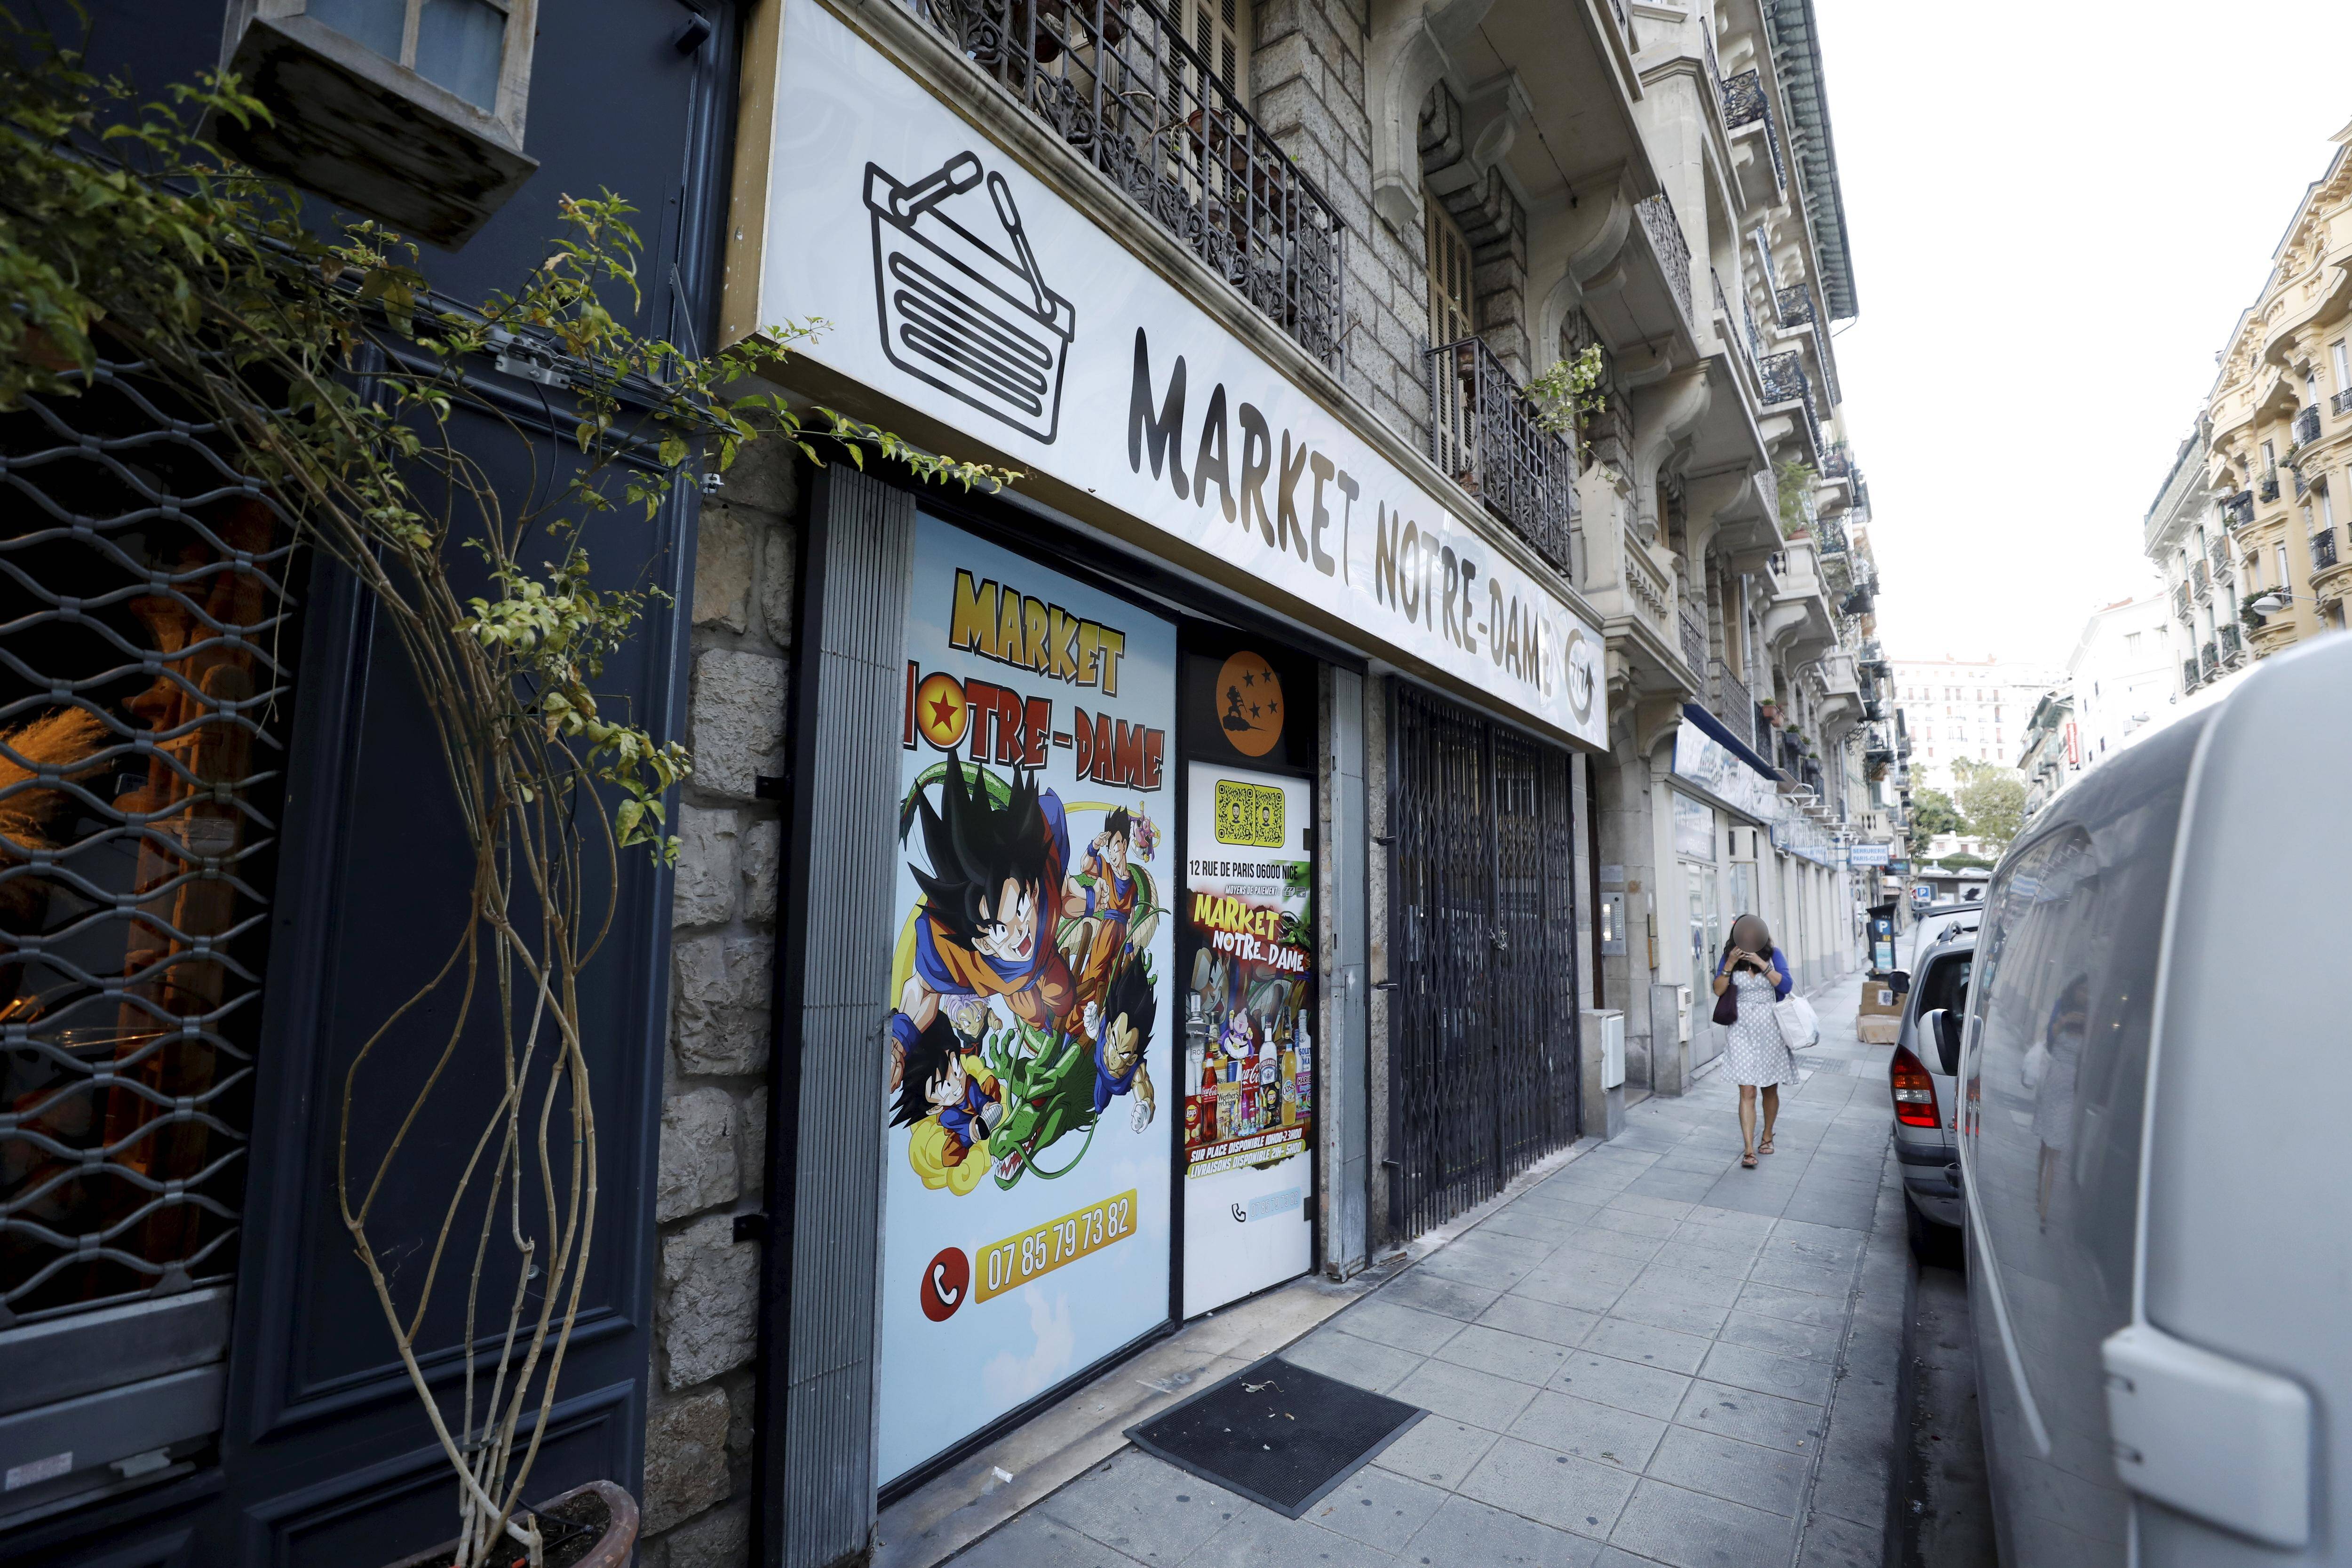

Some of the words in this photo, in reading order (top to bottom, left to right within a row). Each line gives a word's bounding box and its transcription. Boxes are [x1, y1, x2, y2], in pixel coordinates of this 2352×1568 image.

[1128, 326, 1359, 587] MARKET
[948, 567, 1126, 698] MARKET
[904, 659, 1166, 793] OTRE-DAME
[1190, 860, 1200, 876] 12
[1202, 861, 1218, 876] RUE
[1220, 861, 1230, 877] DE
[1232, 862, 1254, 878] PARIS
[1256, 864, 1280, 879] 06000
[1282, 865, 1298, 880] NICE
[1225, 885, 1246, 895] MOYENS
[1247, 886, 1253, 895] DE
[1193, 894, 1279, 941] MARKET
[1879, 920, 1888, 933] P
[1218, 1091, 1239, 1102] Werther's
[1282, 1083, 1295, 1095] Oasis
[1191, 1148, 1204, 1162] SUR
[1206, 1143, 1227, 1159] PLACE
[1228, 1136, 1264, 1154] DISPONIBLE
[1190, 1158, 1232, 1178] LIVRAISONS
[1232, 1149, 1270, 1168] DISPONIBLE
[1251, 1202, 1260, 1217] 07
[1261, 1199, 1269, 1214] 85
[1271, 1196, 1279, 1211] 79
[1280, 1194, 1288, 1209] 73
[1290, 1191, 1298, 1205] 82
[987, 1242, 1016, 1291] 07
[1021, 1229, 1047, 1276] 85
[1053, 1218, 1077, 1263] 79
[1081, 1207, 1103, 1250] 73
[1107, 1197, 1128, 1238] 82
